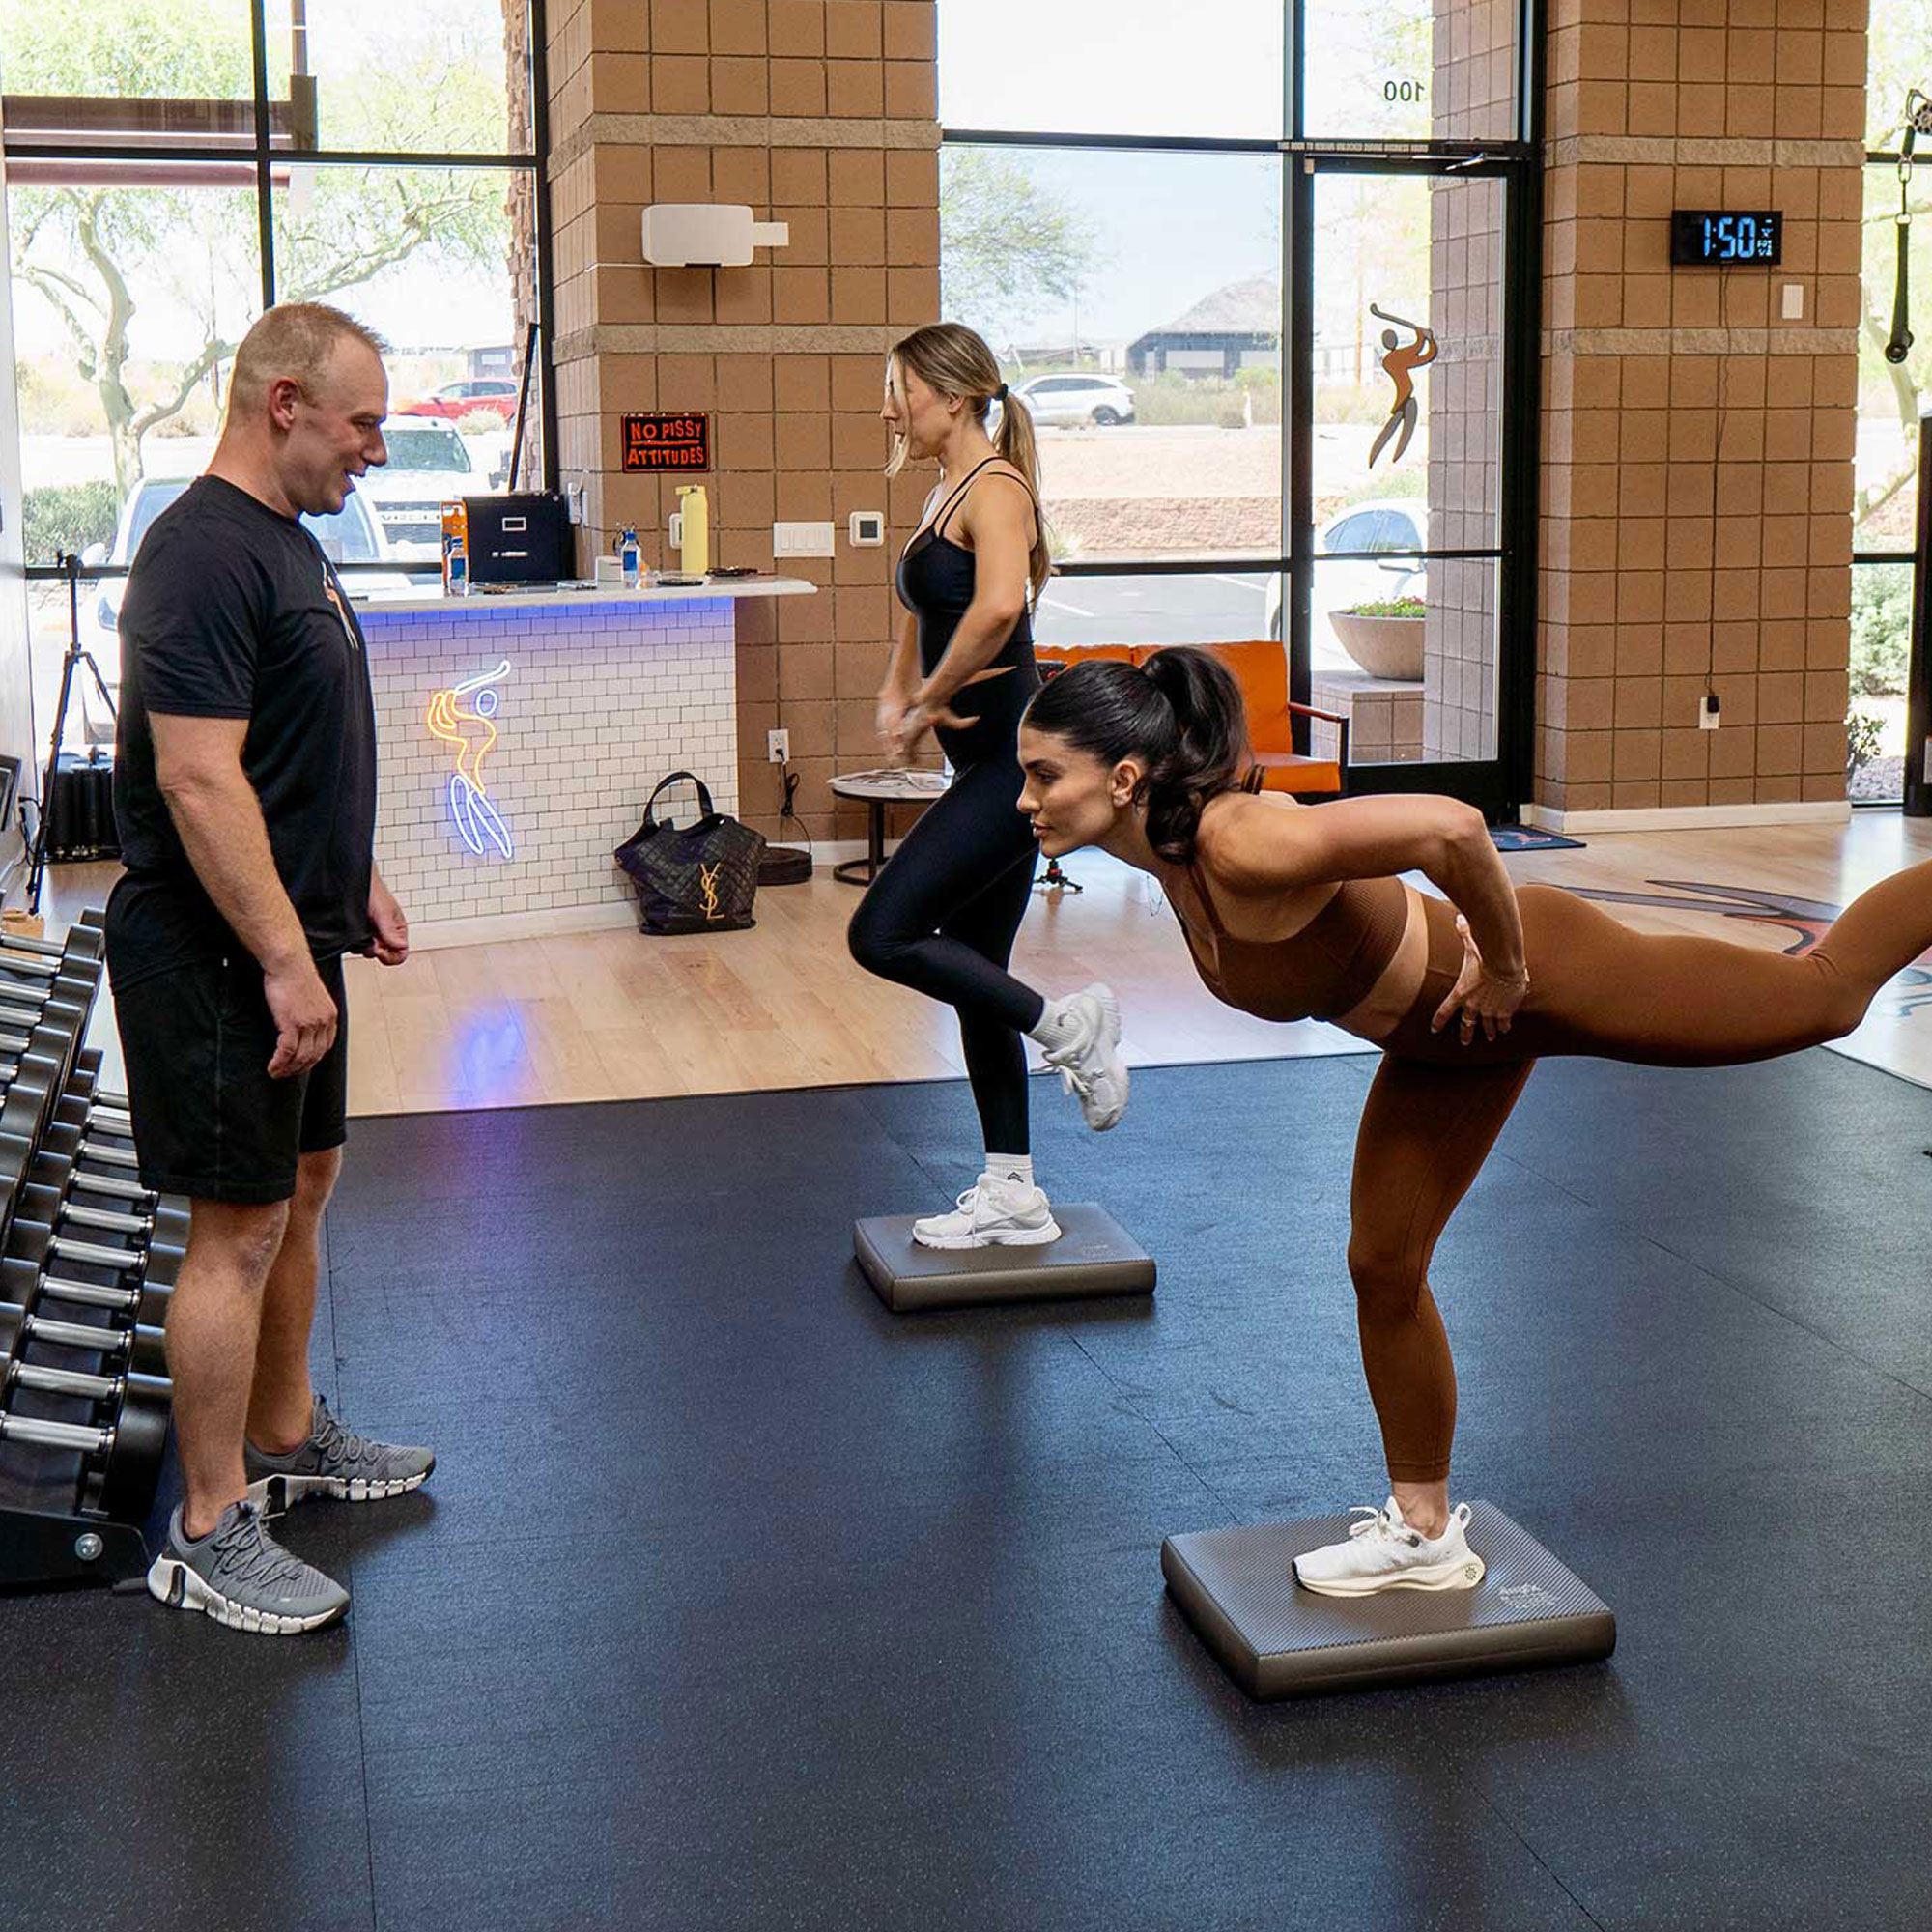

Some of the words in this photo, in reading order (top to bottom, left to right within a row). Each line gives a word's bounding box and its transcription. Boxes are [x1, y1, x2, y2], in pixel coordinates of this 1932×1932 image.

[1704, 216, 1756, 258] 1:50
[630, 422, 657, 440] NO
[662, 419, 702, 439] PISSY
[628, 446, 704, 465] ATTITUDES
[699, 862, 725, 920] YSL
